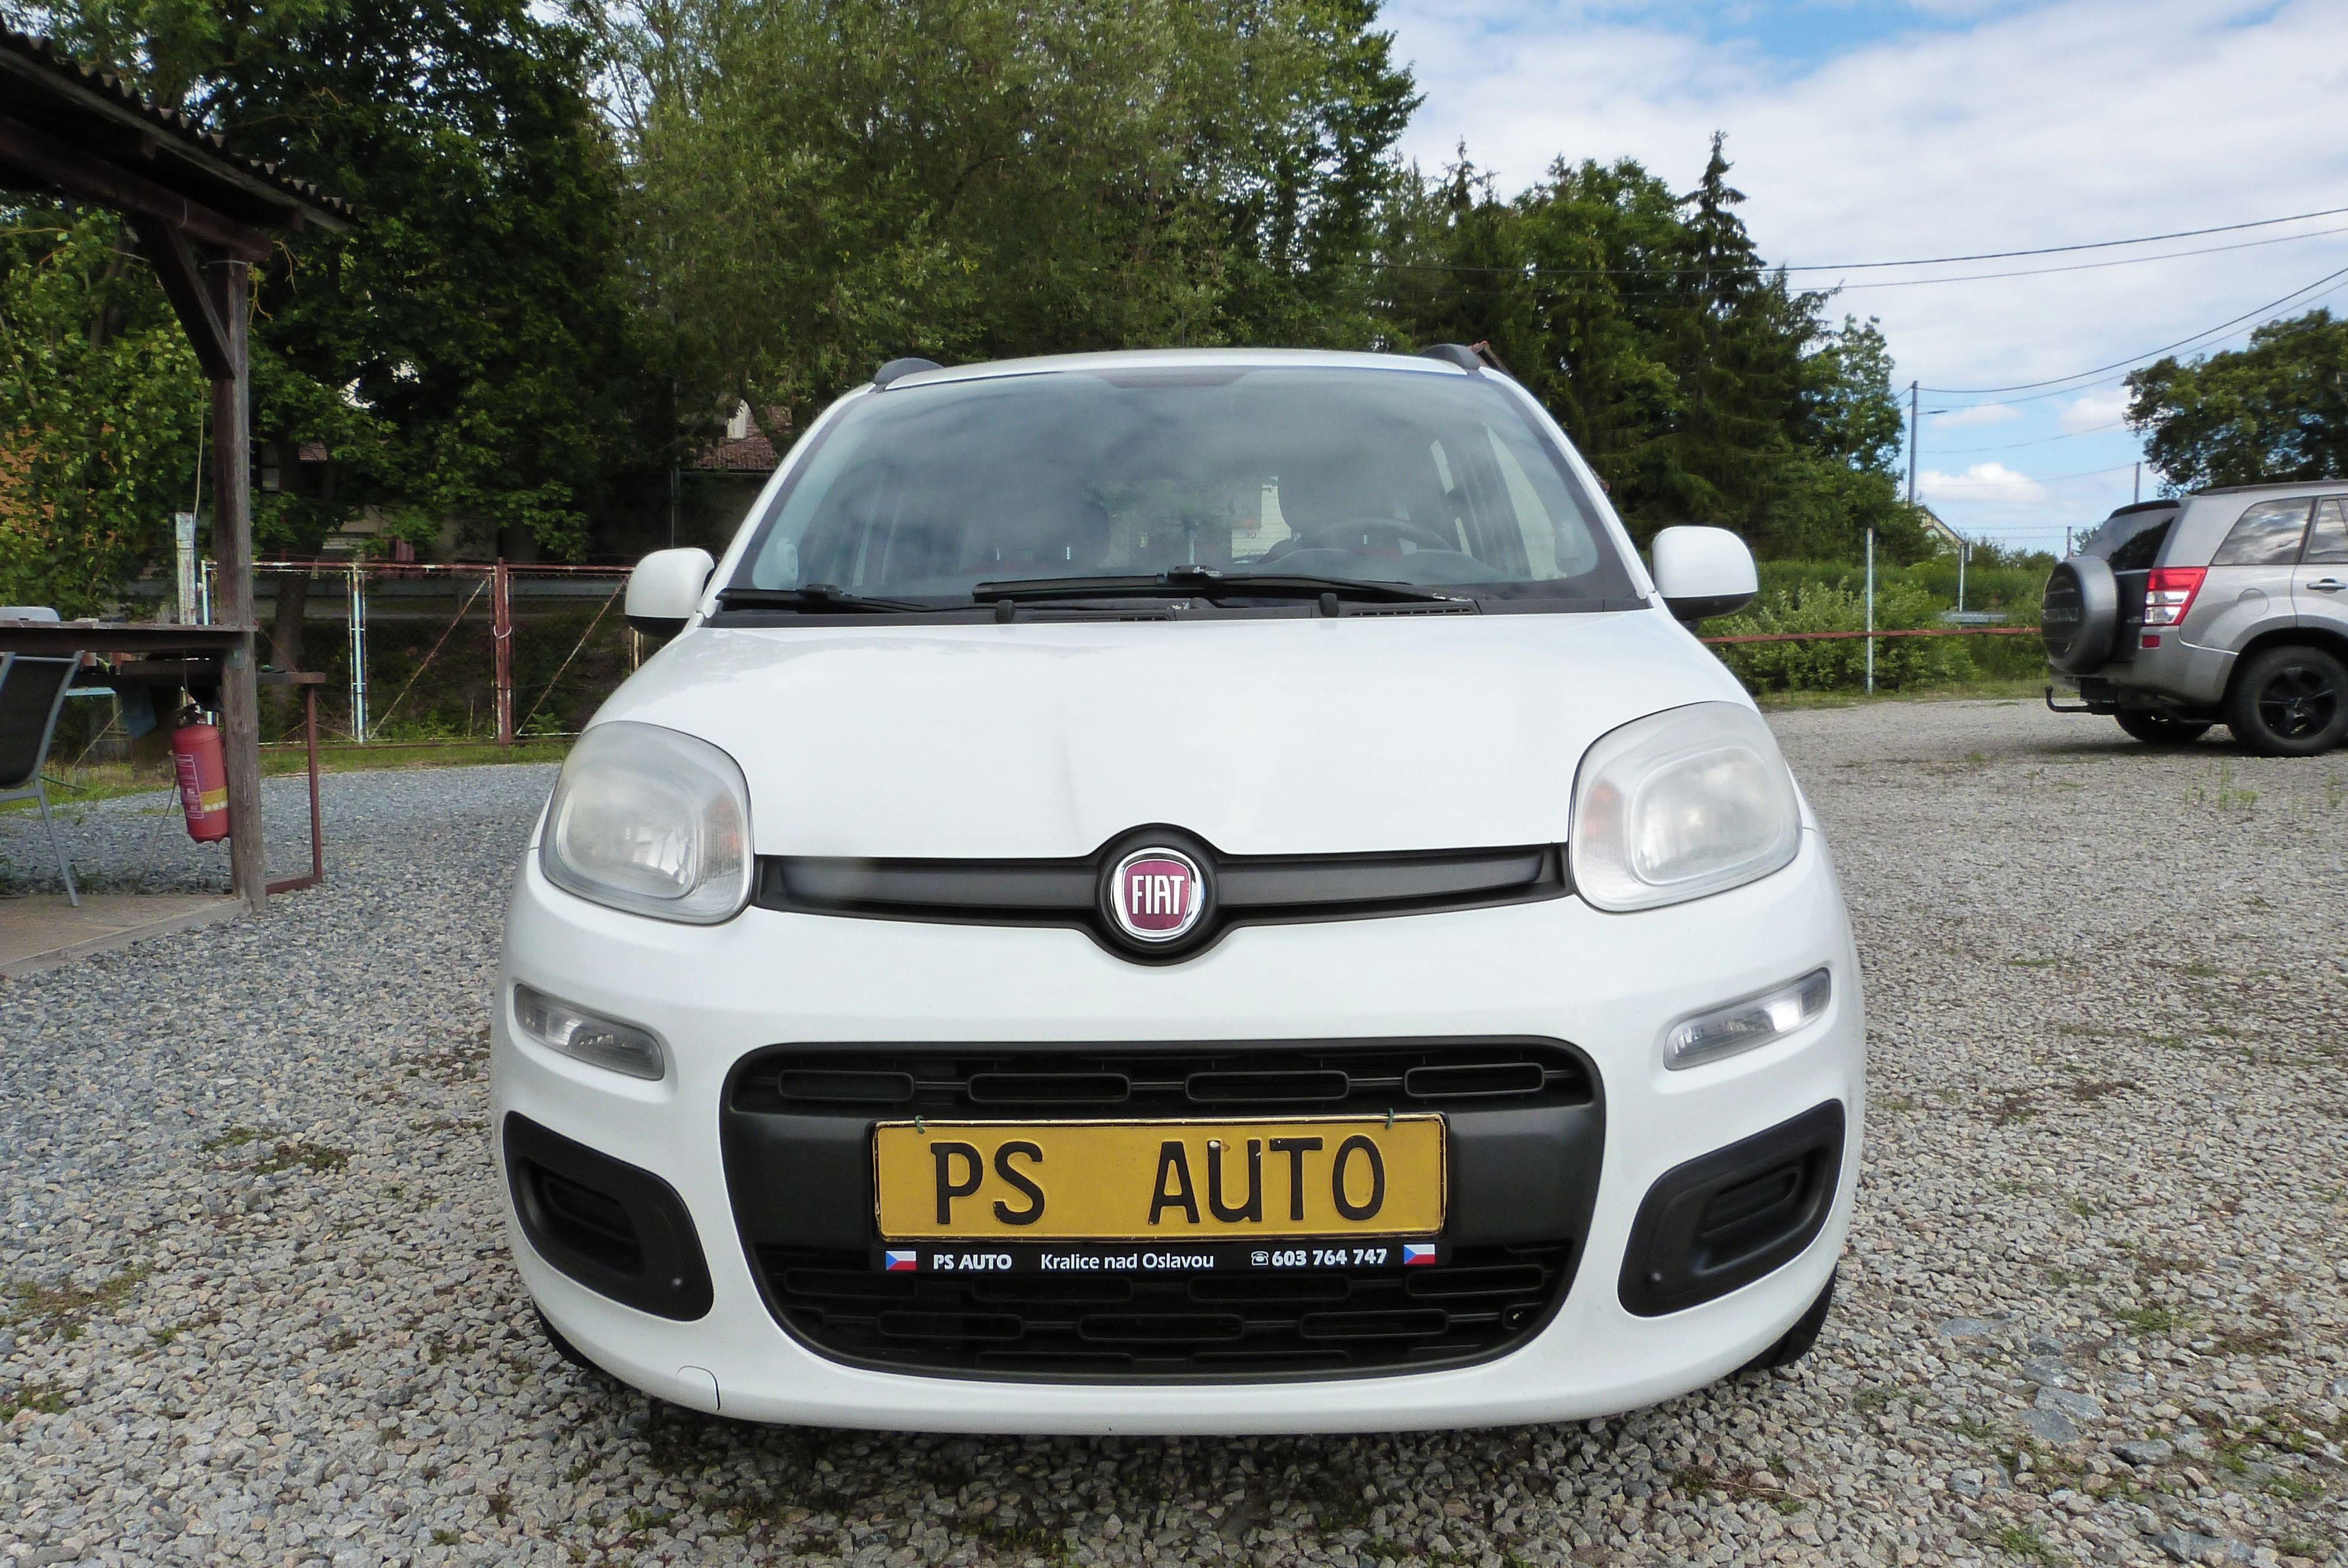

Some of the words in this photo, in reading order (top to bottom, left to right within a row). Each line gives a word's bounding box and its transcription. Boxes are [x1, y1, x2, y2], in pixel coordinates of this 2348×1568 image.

[1131, 875, 1185, 915] FIAT
[930, 1141, 1045, 1226] PS
[1148, 1135, 1385, 1225] AUTO
[933, 1254, 954, 1270] PS
[958, 1254, 1012, 1270] AUTO
[1041, 1253, 1100, 1269] Kralice
[1104, 1253, 1138, 1269] nad
[1142, 1252, 1214, 1269] Oslavou
[1271, 1250, 1307, 1266] 603
[1313, 1249, 1348, 1266] 764
[1353, 1248, 1387, 1265] 747
